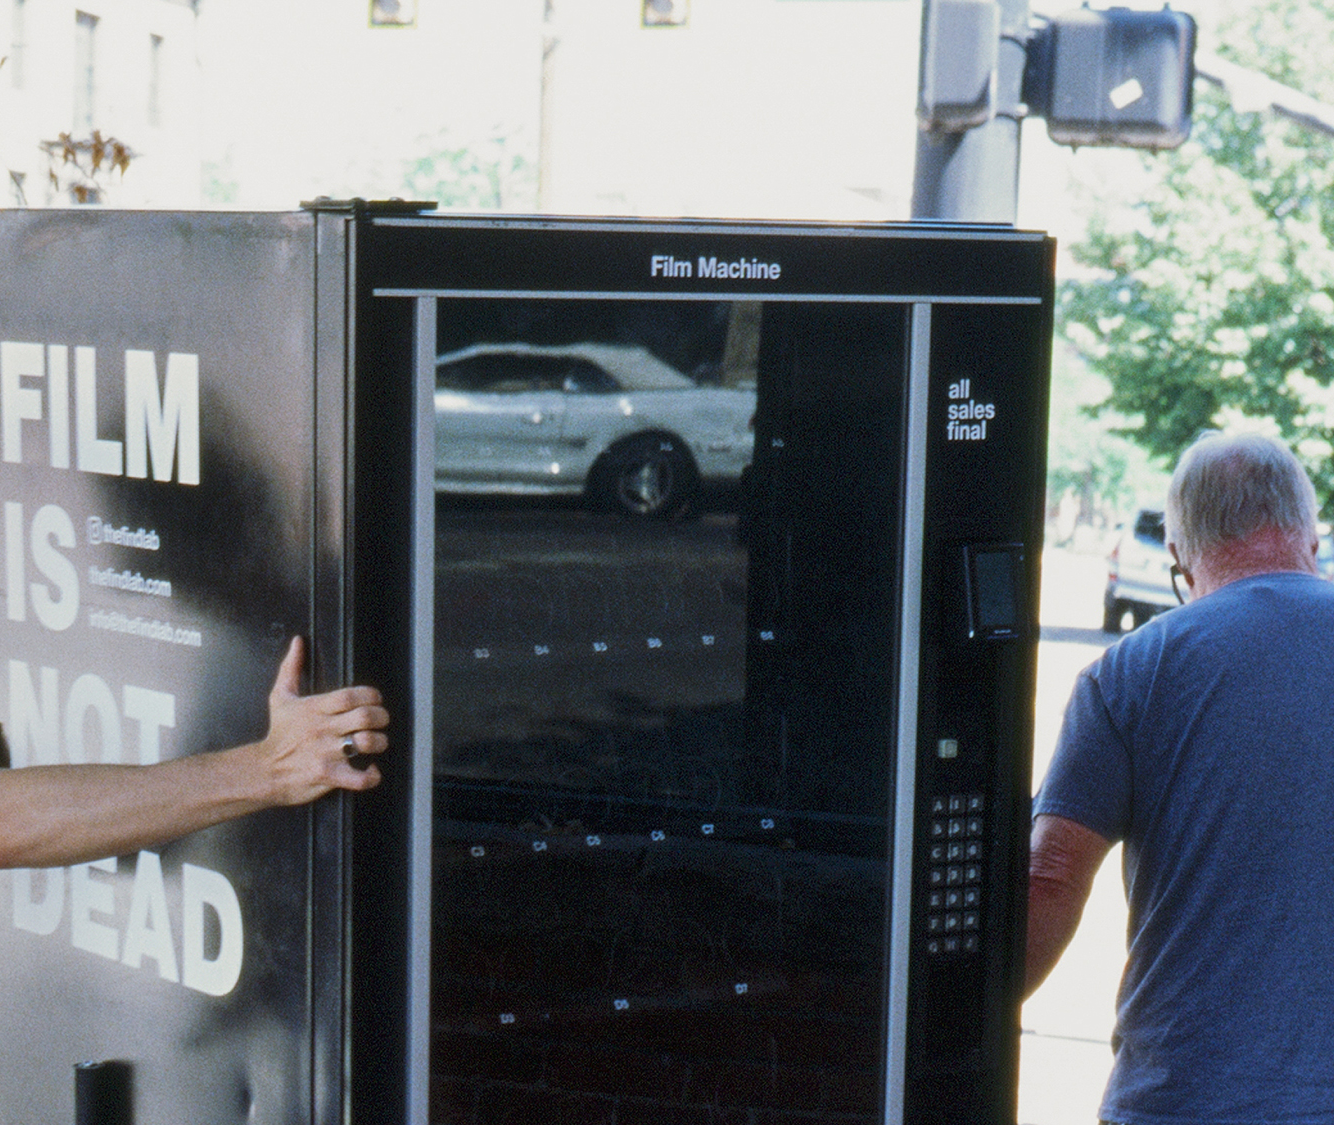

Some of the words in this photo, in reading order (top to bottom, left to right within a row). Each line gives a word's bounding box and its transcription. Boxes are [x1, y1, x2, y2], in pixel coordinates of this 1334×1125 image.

[651, 255, 692, 277] Film
[698, 256, 781, 280] Machine
[0, 341, 200, 485] FILM
[948, 378, 970, 399] all
[948, 399, 995, 420] sales
[947, 420, 986, 440] final
[5, 502, 79, 632] IS
[9, 660, 175, 768] NOT
[11, 851, 243, 997] DEAD
